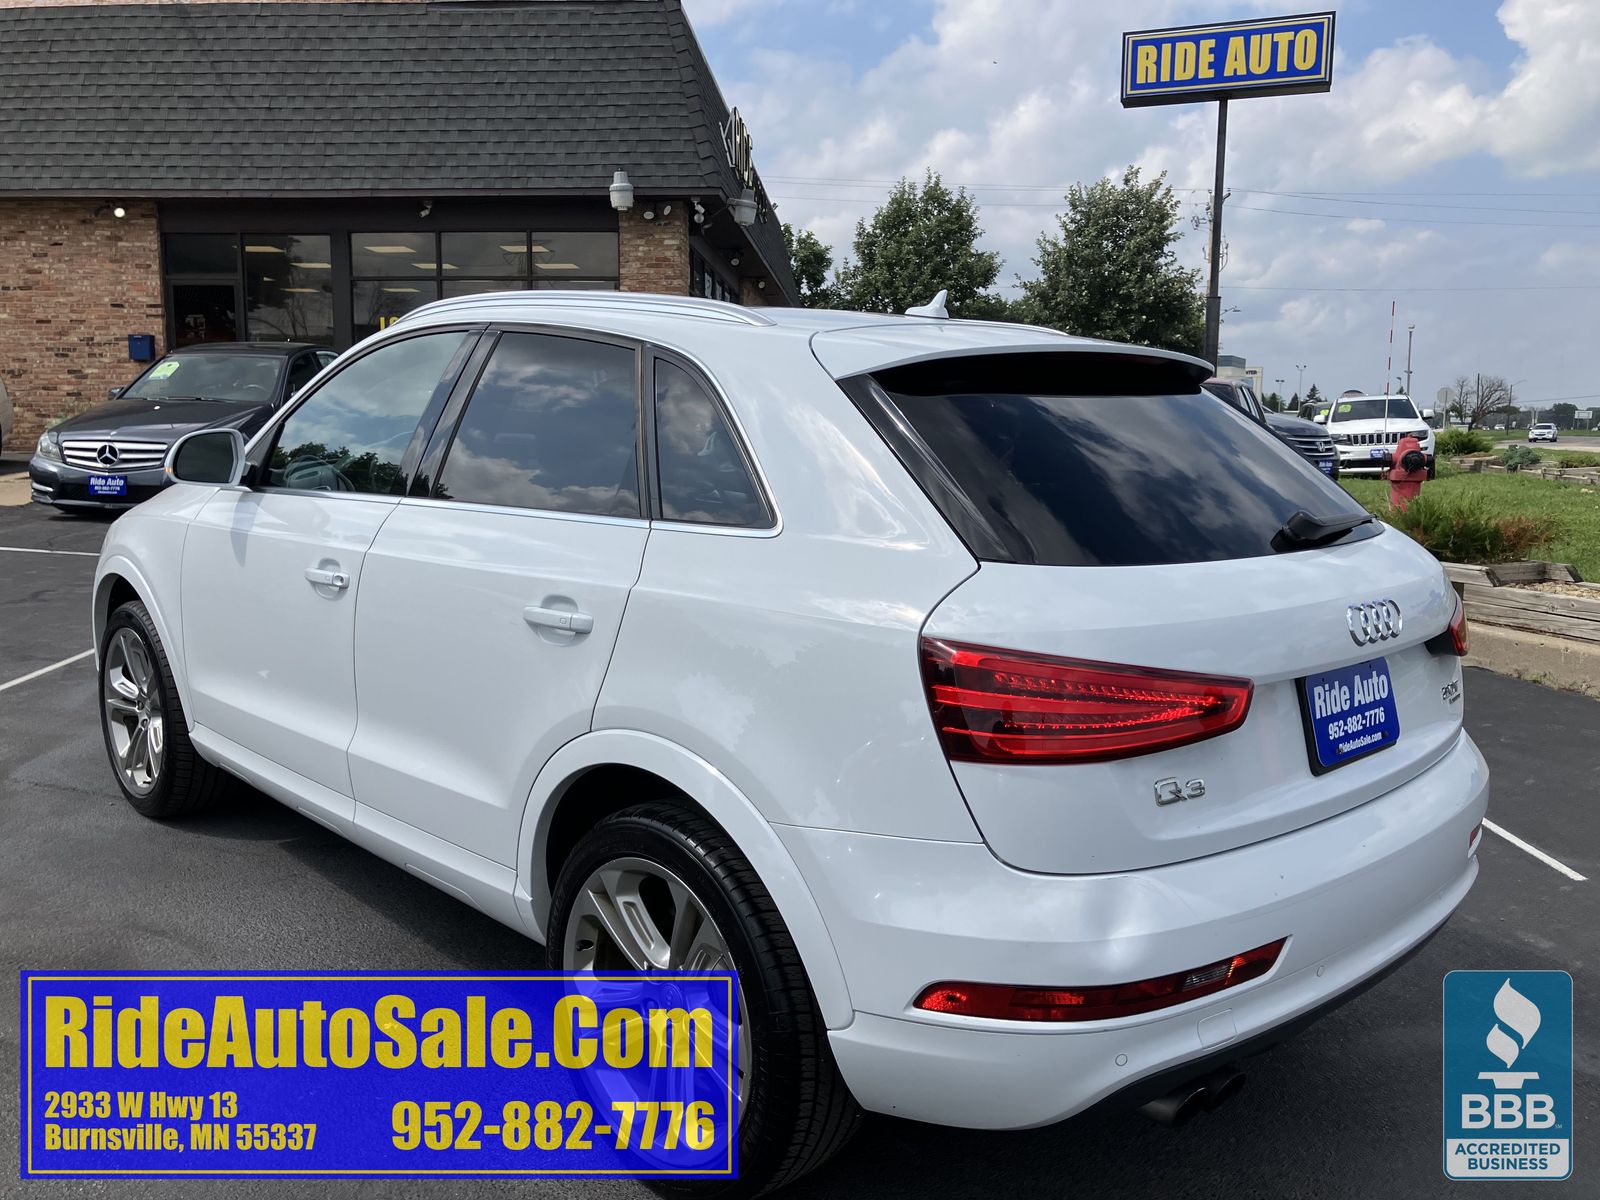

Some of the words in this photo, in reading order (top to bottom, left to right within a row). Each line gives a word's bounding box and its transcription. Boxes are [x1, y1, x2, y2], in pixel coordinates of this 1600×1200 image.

[1136, 38, 1216, 84] RIDE
[1223, 29, 1318, 77] AUTO
[1313, 680, 1350, 720] Ride
[1353, 670, 1389, 708] Auto
[1328, 706, 1385, 740] 952-882-7776
[1338, 731, 1382, 754] RideAutoSale.com
[1154, 777, 1206, 807] Q3
